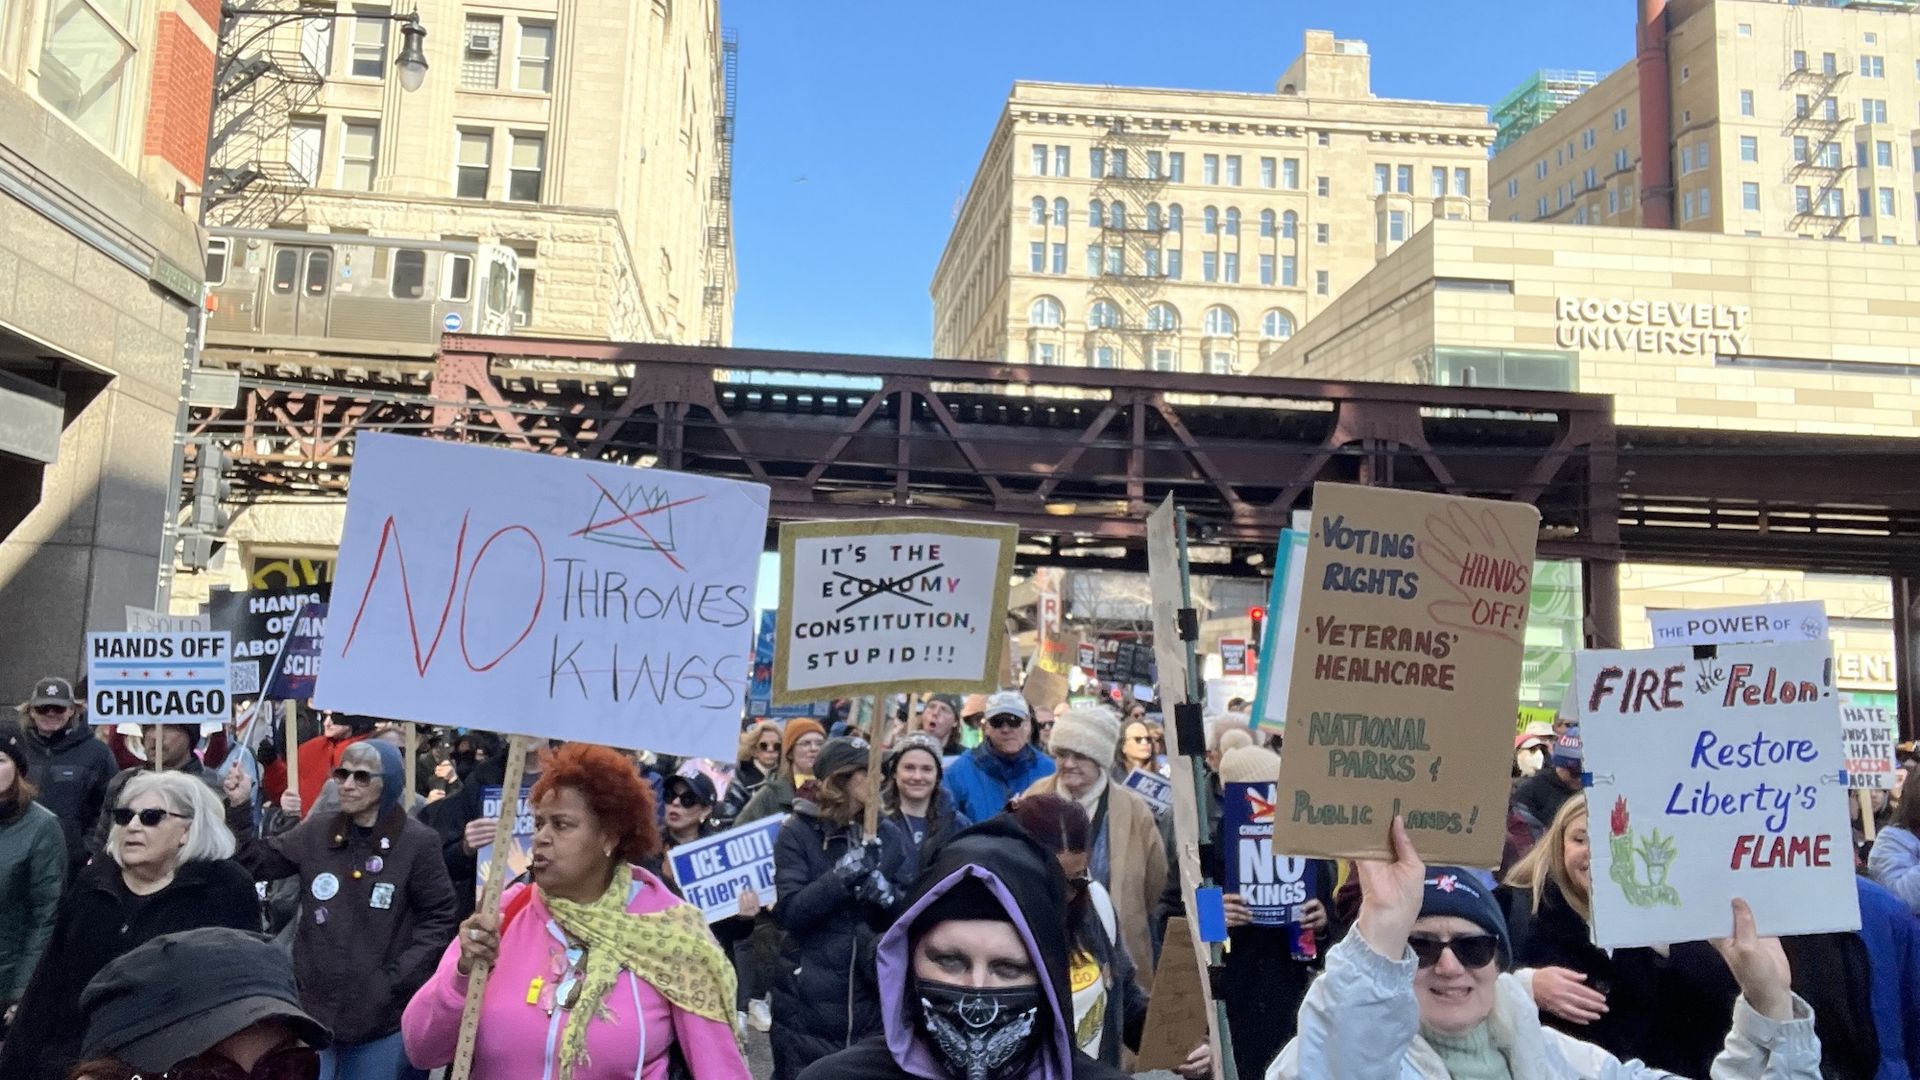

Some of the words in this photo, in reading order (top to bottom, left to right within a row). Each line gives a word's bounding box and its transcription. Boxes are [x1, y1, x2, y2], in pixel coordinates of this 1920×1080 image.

[1556, 296, 1748, 331] ROOSEVELT
[1556, 325, 1749, 356] UNIVERSITY
[1322, 515, 1416, 559] VOTING
[821, 544, 866, 566] IT'S
[890, 544, 941, 562] THE
[822, 576, 960, 598] ECONOMY
[1323, 563, 1419, 600] RIGHTS
[1460, 552, 1529, 595] HANDS
[343, 508, 546, 678] NO
[554, 558, 750, 627] THRONES
[795, 611, 976, 640] CONSTITUTION,
[1472, 598, 1525, 630] OFF!
[1657, 626, 1684, 639] THE
[1687, 615, 1769, 637] POWER
[1773, 619, 1792, 631] OF
[94, 638, 173, 659] HANDS
[181, 637, 226, 658] OFF
[233, 638, 285, 658] ABO
[1316, 615, 1460, 658] VETERANS'
[549, 634, 741, 709] KINGS
[807, 646, 955, 670] STUPID!!!
[95, 688, 226, 716] CHICAGO
[1588, 662, 1686, 714] FIRE
[1722, 657, 1832, 708] Felon!
[1308, 711, 1431, 751] NATIONAL
[1843, 708, 1886, 722] HATE
[1328, 750, 1416, 782] PARKS
[1690, 730, 1818, 770] Restore
[1850, 743, 1891, 759] HATE
[1665, 782, 1817, 833] Liberty's
[690, 845, 726, 879] ICE
[725, 829, 773, 867] OUT!
[1239, 838, 1306, 883] NO
[1730, 834, 1832, 870] FLAME
[756, 862, 775, 889] IC
[1239, 880, 1307, 906] KINGS
